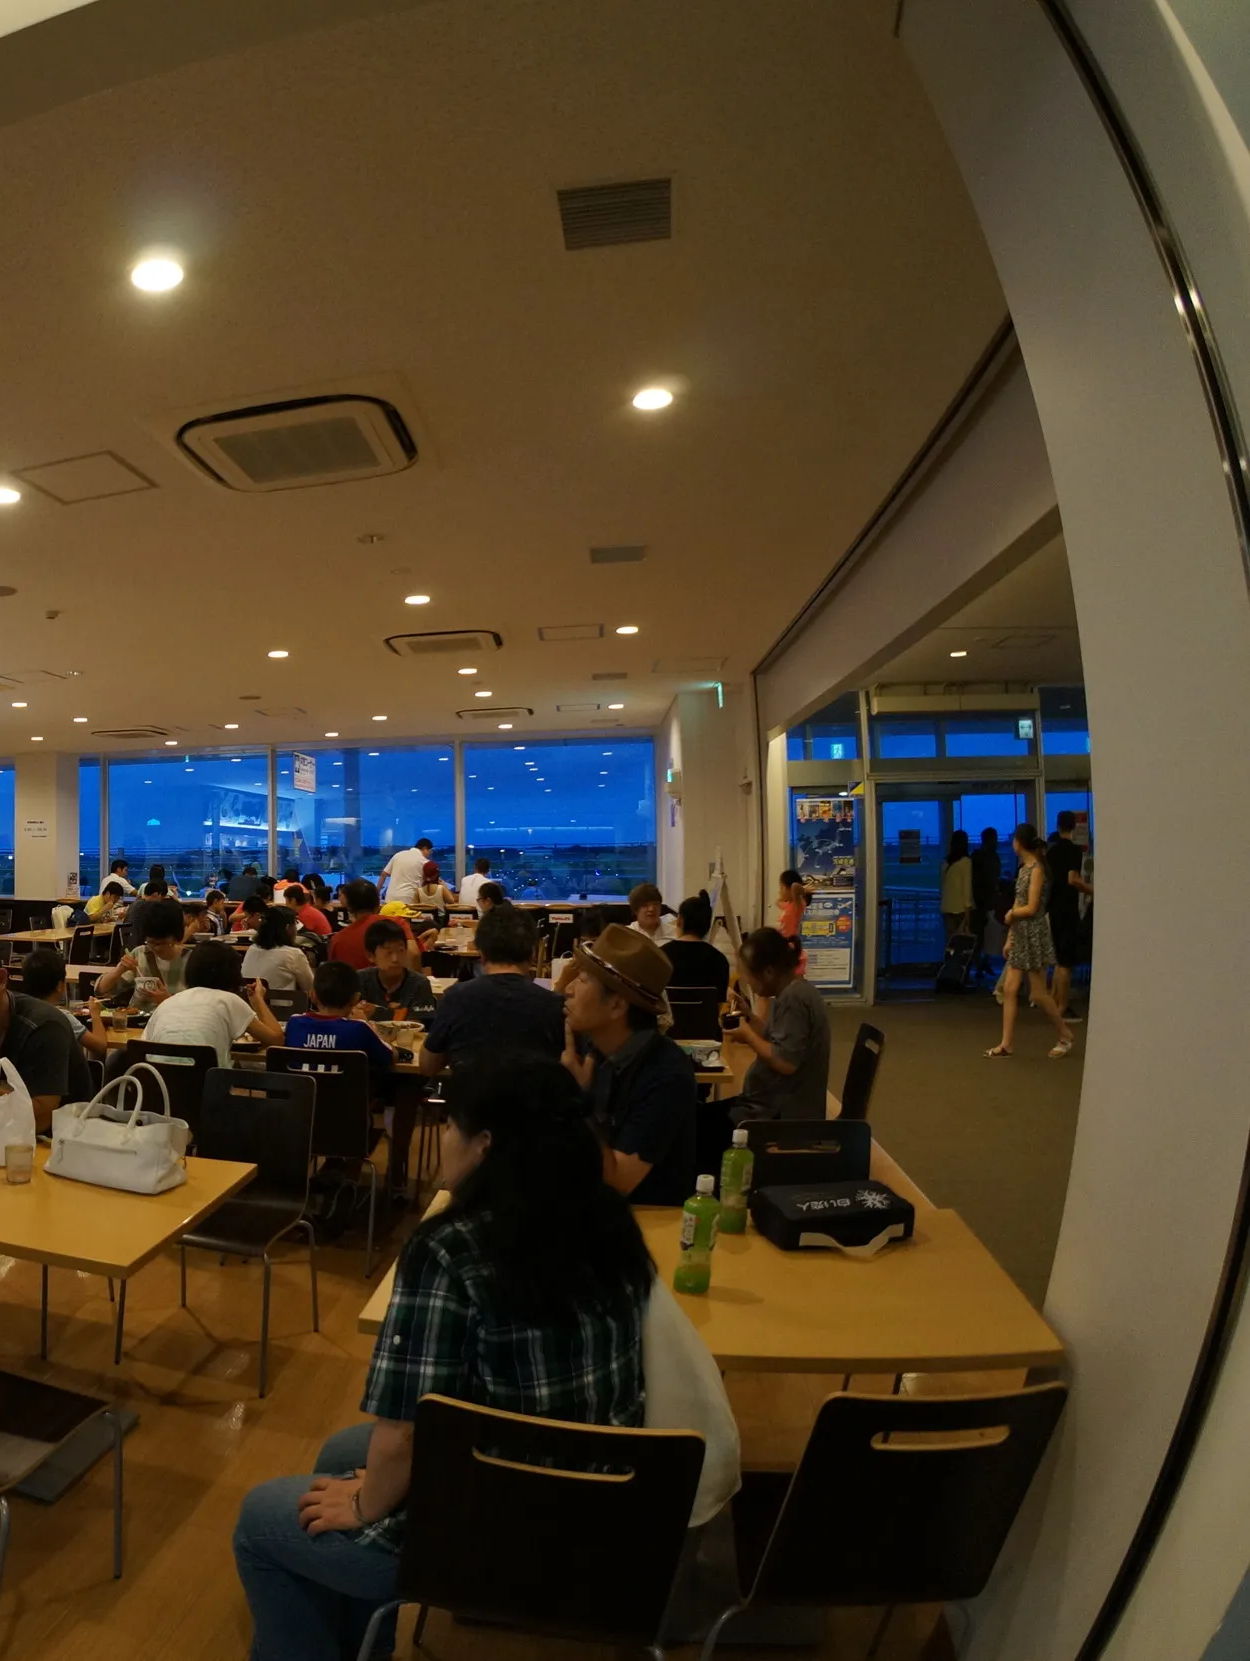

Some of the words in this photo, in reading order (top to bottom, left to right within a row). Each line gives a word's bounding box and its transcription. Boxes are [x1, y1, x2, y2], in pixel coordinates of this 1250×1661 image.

[303, 1033, 337, 1049] JAPAN
[797, 1198, 850, 1211] 白い恋人
